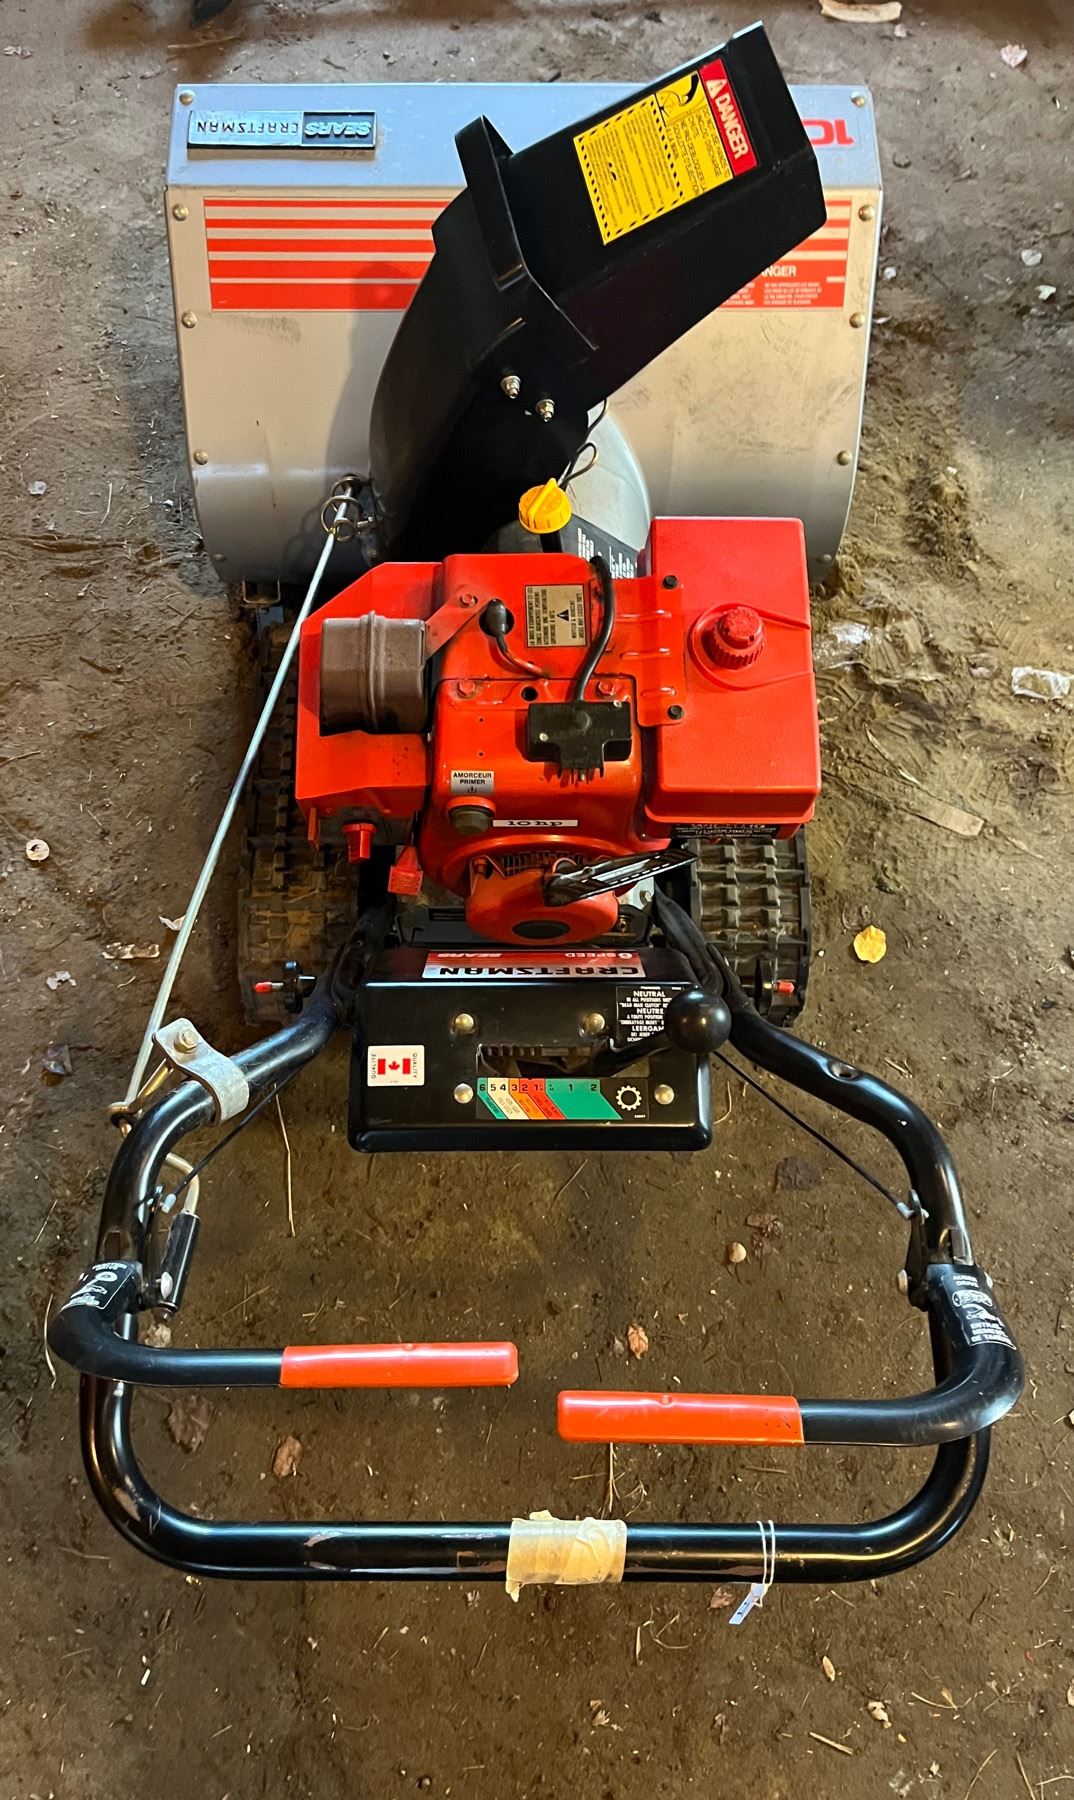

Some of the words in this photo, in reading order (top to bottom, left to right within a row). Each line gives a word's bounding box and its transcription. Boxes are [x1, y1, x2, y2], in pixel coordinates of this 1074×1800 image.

[197, 121, 299, 133] CRAFTSMAN
[305, 122, 371, 137] SEARS
[715, 93, 749, 159] DANGER
[761, 265, 797, 277] ANGER
[440, 967, 638, 975] CRAFTSMAN
